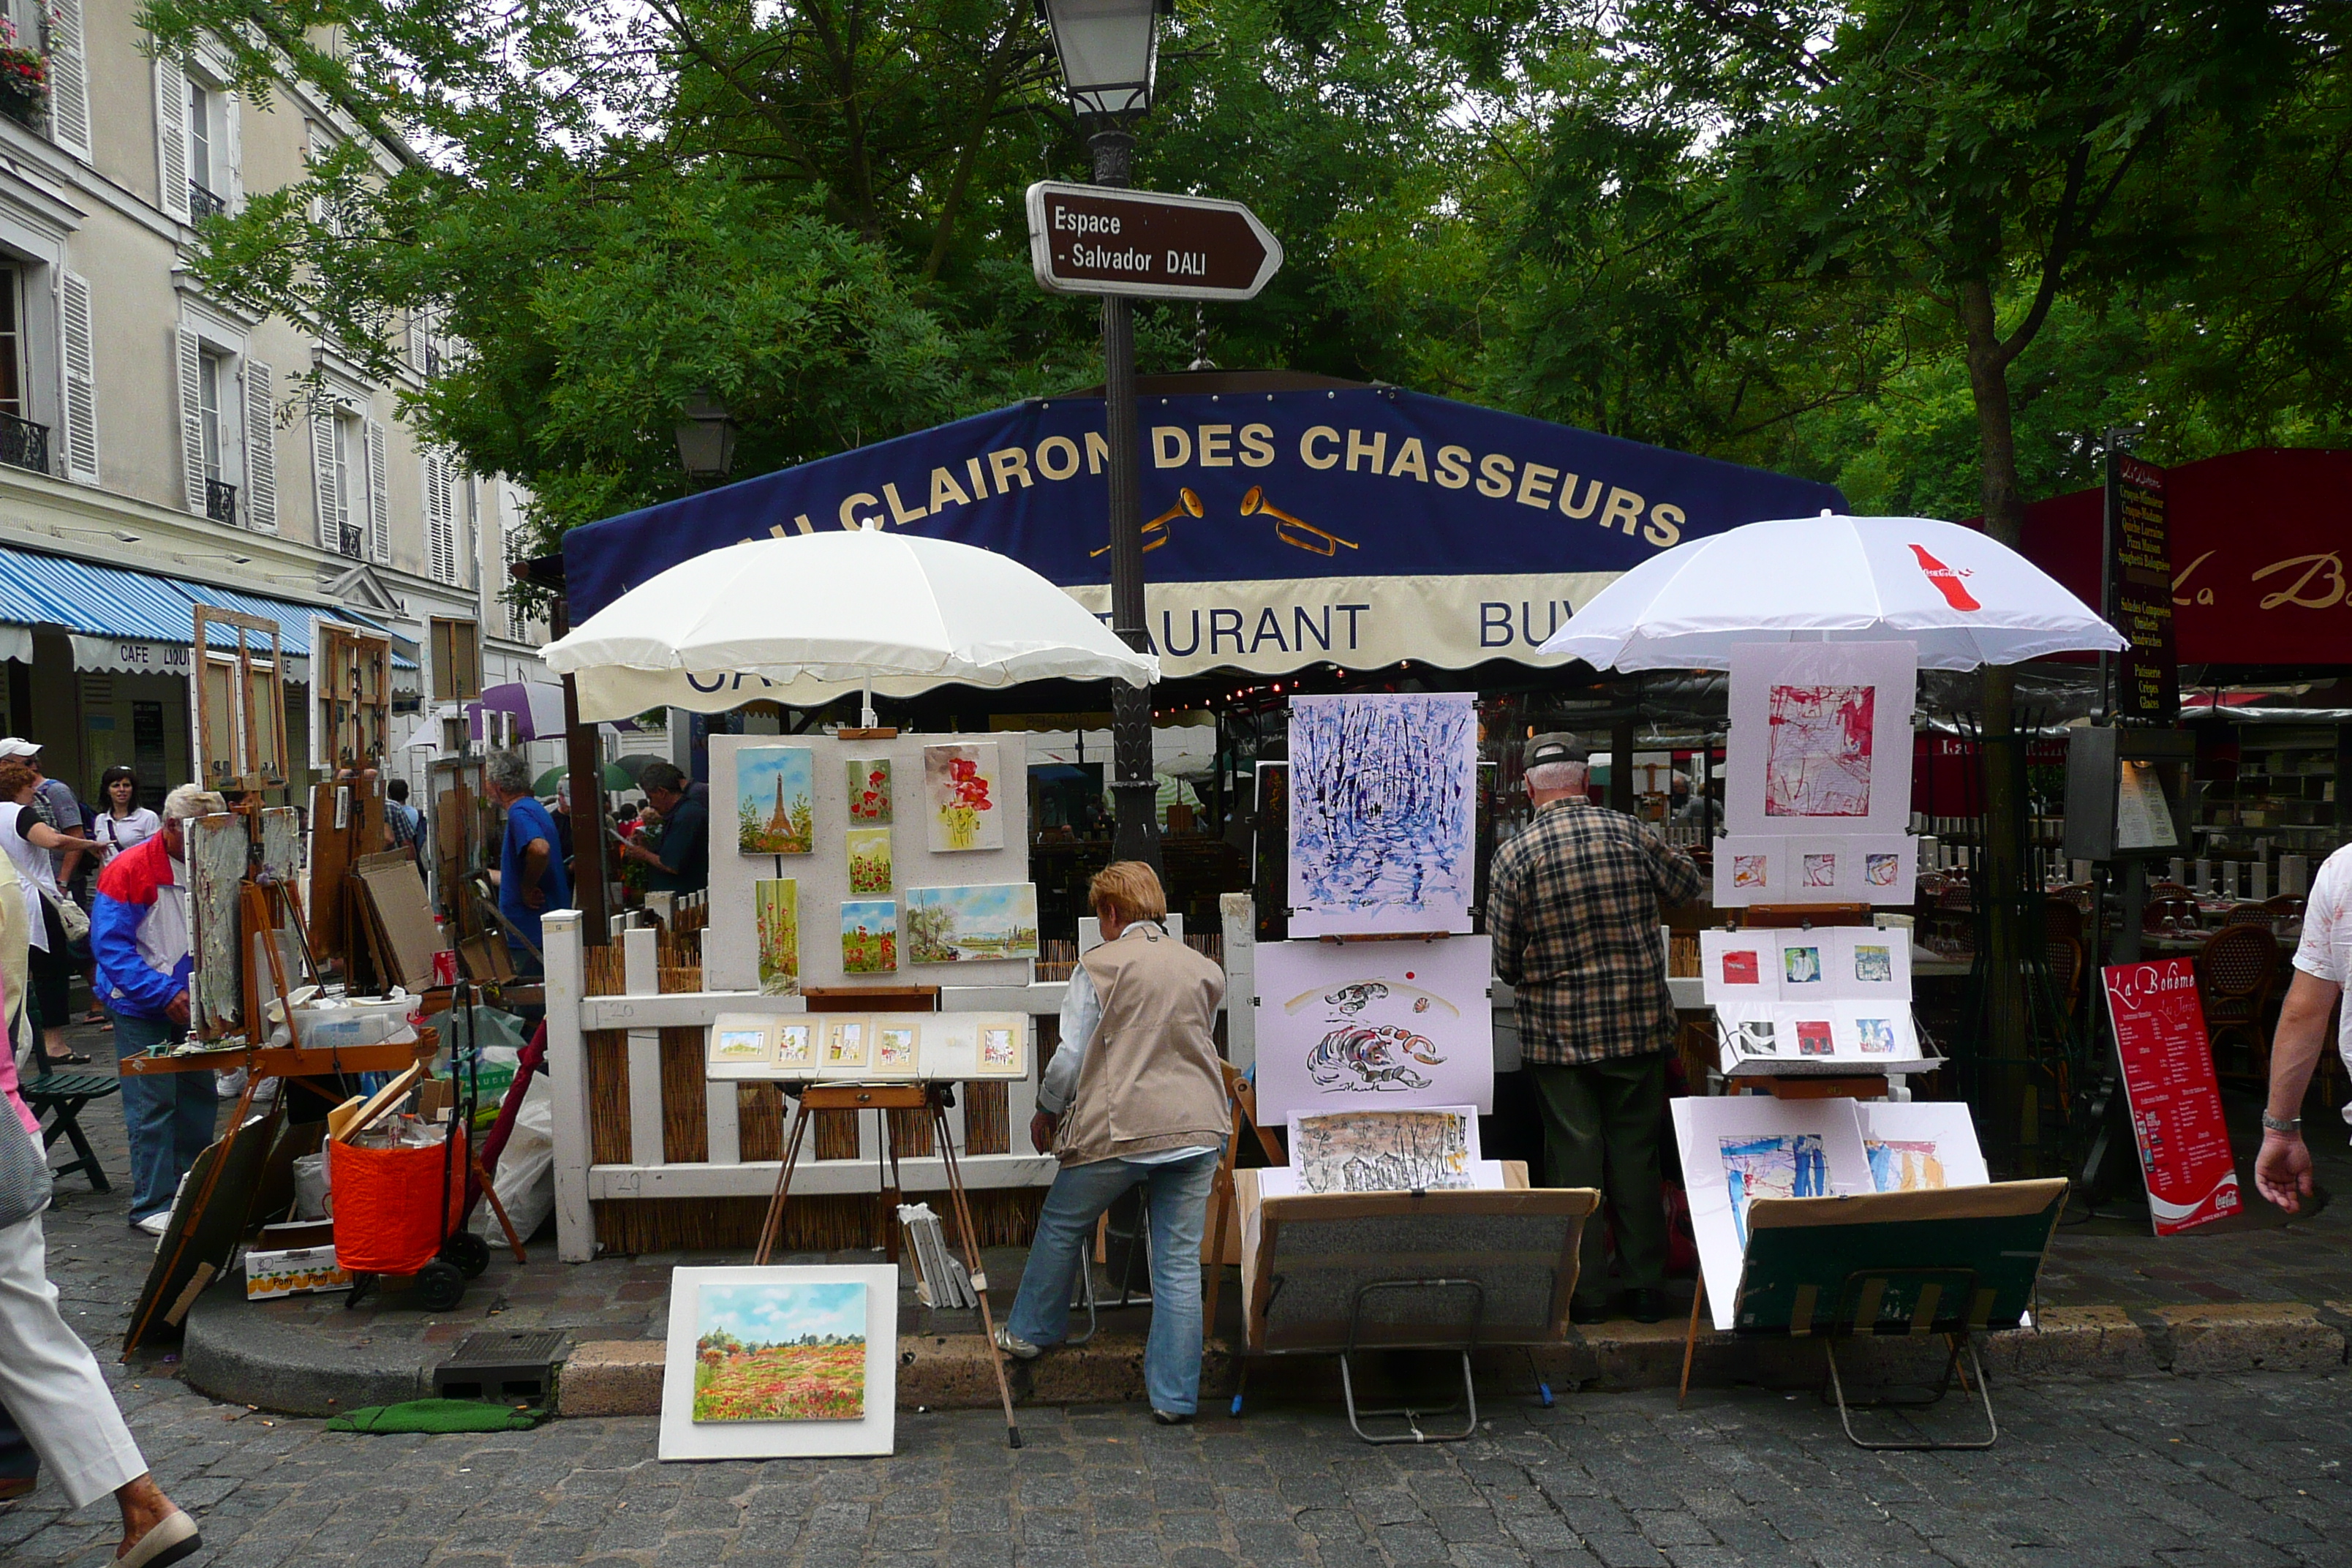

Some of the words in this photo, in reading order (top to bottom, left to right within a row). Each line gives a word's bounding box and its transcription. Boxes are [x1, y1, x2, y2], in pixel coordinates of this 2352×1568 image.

[1055, 206, 1120, 238] Espace
[1072, 243, 1152, 272] Salvador
[1166, 250, 1206, 276] DALI
[1152, 423, 1275, 469] DES
[1300, 425, 1686, 547] CHASSEURS
[121, 645, 148, 663] CAFE
[2140, 696, 2160, 709] Glaces
[2109, 971, 2141, 1010] La
[2135, 962, 2195, 994] Bohème
[274, 1277, 294, 1286] Pony
[308, 1273, 328, 1284] Pony
